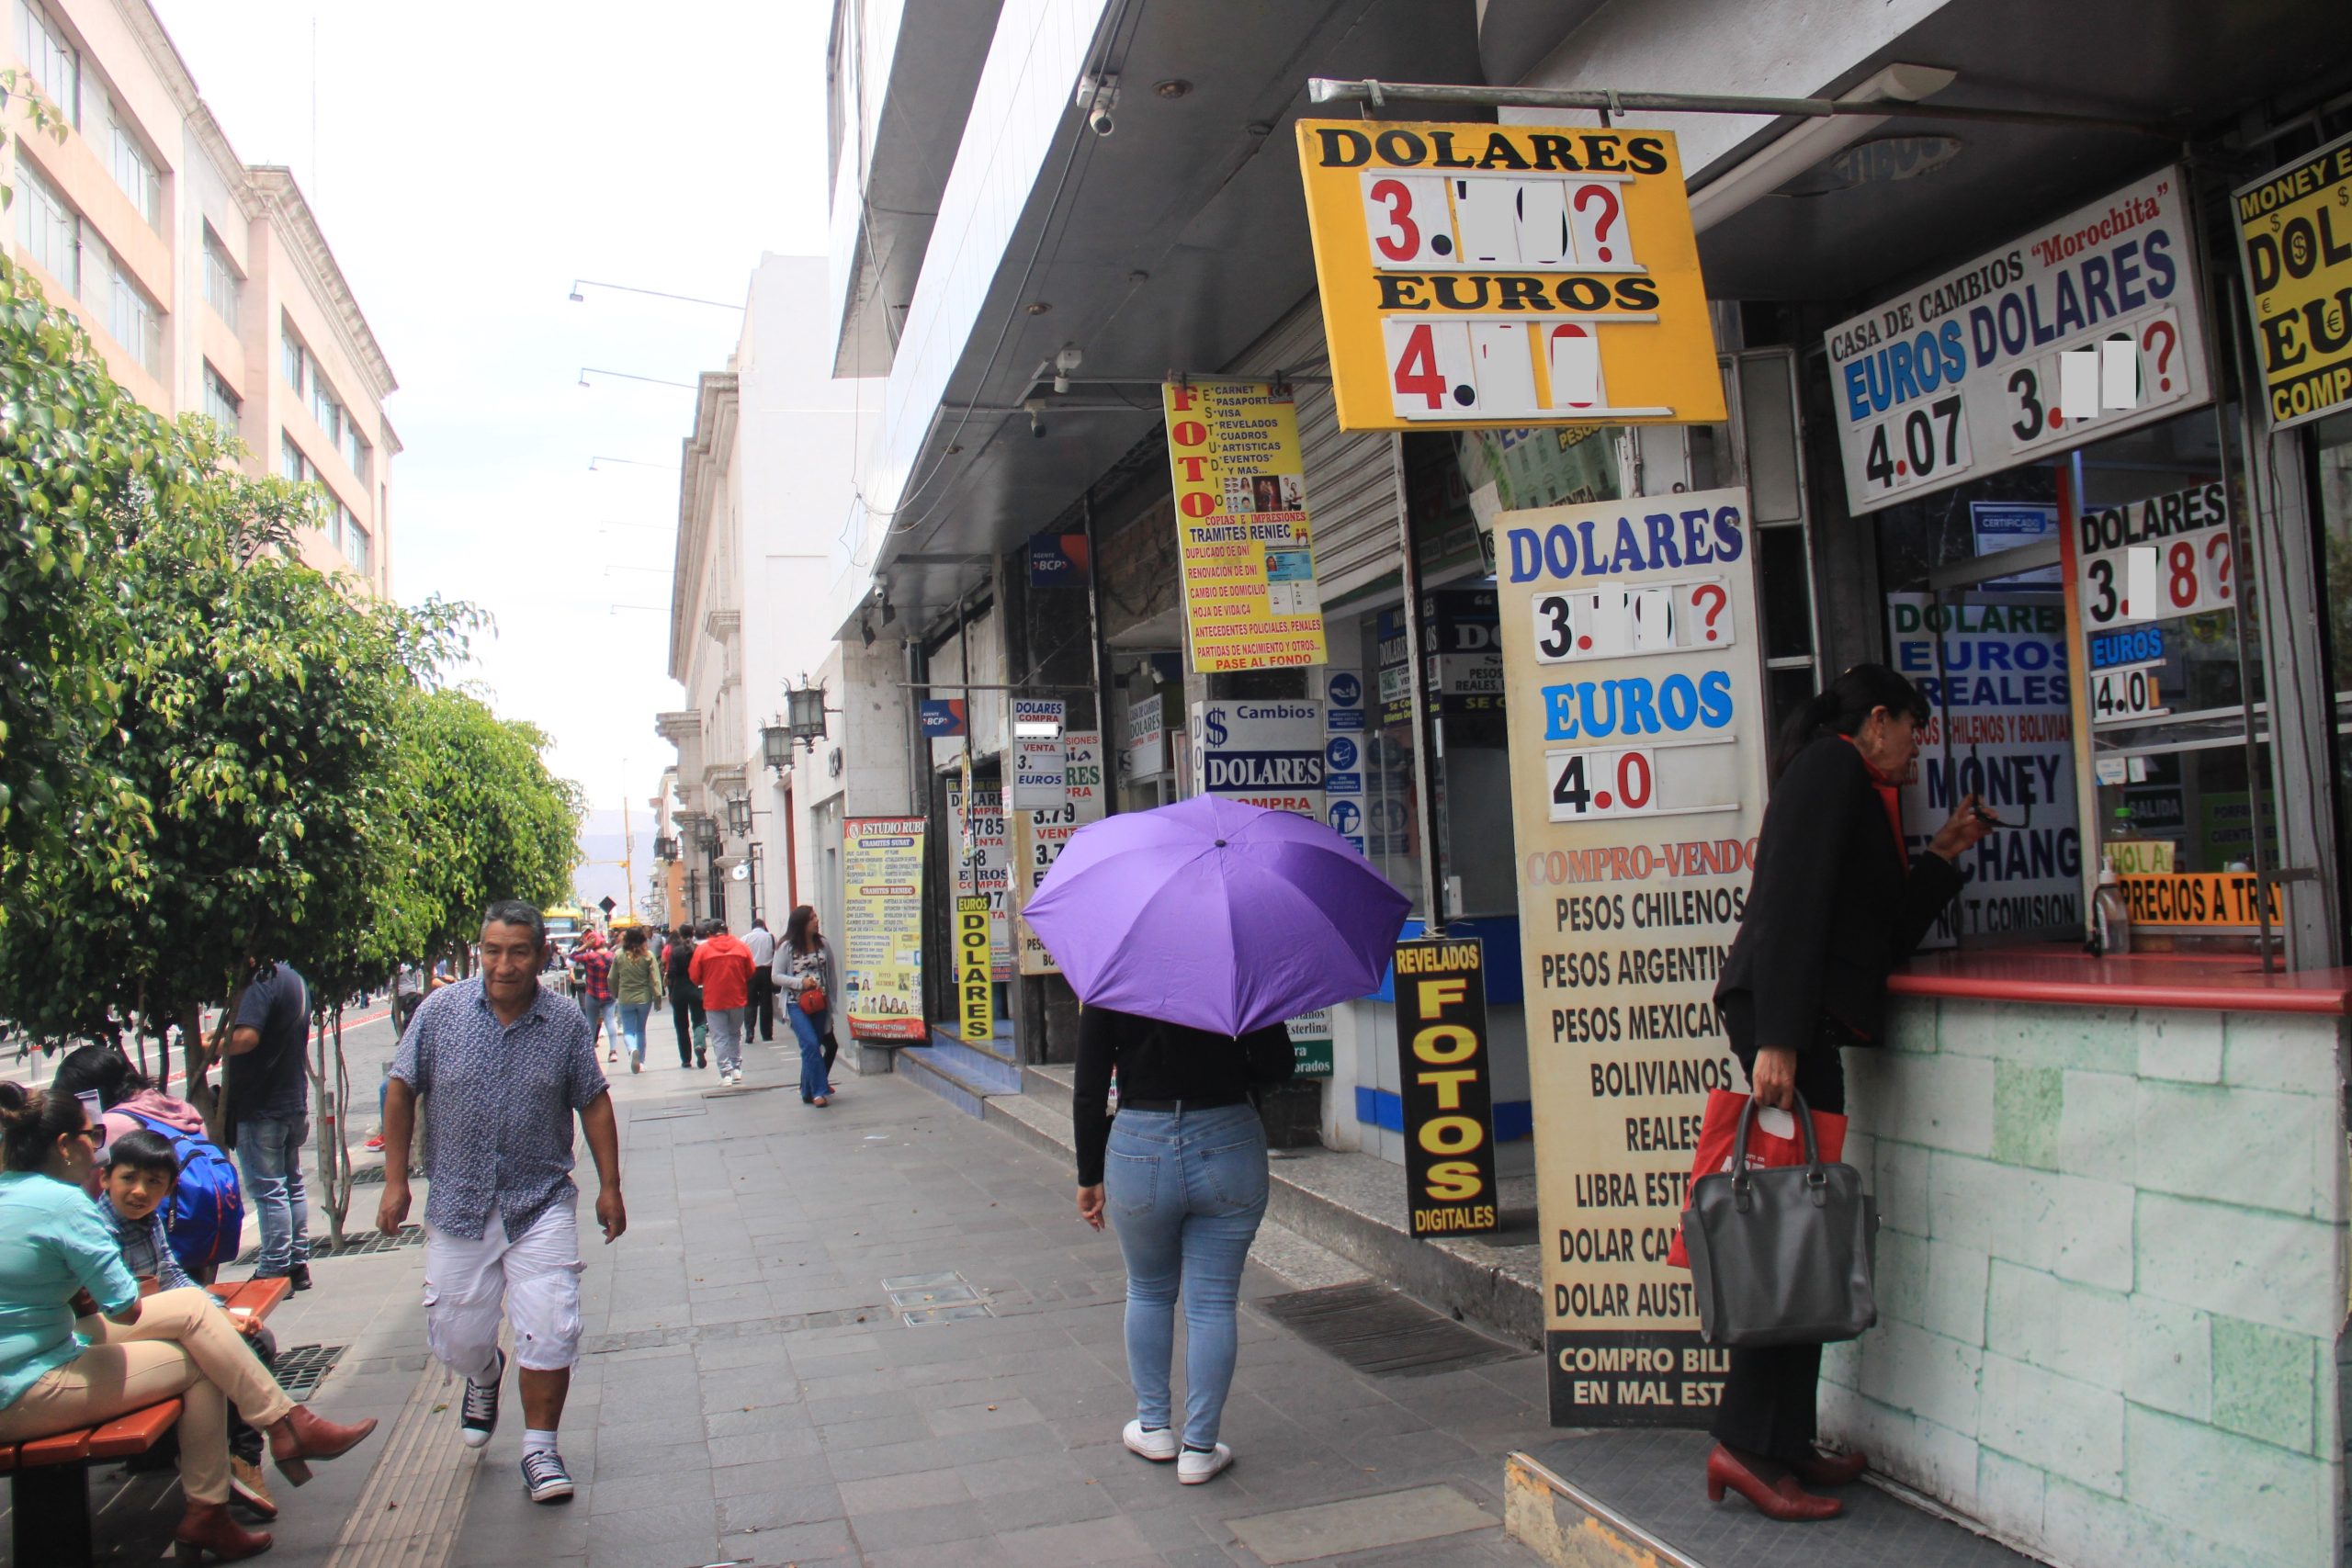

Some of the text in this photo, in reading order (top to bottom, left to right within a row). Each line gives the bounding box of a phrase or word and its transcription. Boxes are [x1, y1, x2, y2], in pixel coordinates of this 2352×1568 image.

[1317, 129, 1668, 175] DOLARES
[2240, 159, 2328, 221] MONEY
[1370, 179, 1619, 263] 3.?
[1374, 276, 1659, 310] EUROS
[1831, 328, 1881, 362] CASA
[1884, 303, 1914, 339] DE
[1918, 250, 2024, 323] CAMBIOS
[1844, 229, 2177, 422] EUROS DOLARES
[1215, 386, 1255, 394] CARNET
[1216, 396, 1275, 405] PASAPORTE
[1866, 320, 2176, 488] 4.07 3.?
[1219, 419, 1278, 429] REVELADOS
[1221, 431, 1268, 440] CUADROS
[1171, 385, 1216, 518] FOTO
[1222, 442, 1281, 452] ARTISTICAS
[1227, 467, 1234, 475] Y
[1190, 525, 1291, 542] TRAMITES RENIEC
[1205, 512, 1306, 525] COPIAS E IMPRESIONES
[2081, 483, 2225, 555] DOLARES
[1186, 546, 1250, 558] DUPLICADO DE DNI
[1508, 506, 1743, 582] DOLARES
[1188, 565, 1257, 579] RENOVACION DE DNI
[2088, 532, 2231, 623] 3.8?
[1190, 583, 1265, 599] CAMBIO DE DOMICILIO
[1193, 606, 1212, 617] HOJA
[1213, 605, 1222, 616] DE
[1539, 584, 1726, 657] 3.?
[1894, 603, 2064, 634] DOLARE
[1195, 624, 1248, 637] ANTECEDENTES
[1291, 619, 1320, 631] PENALES
[1197, 646, 1230, 658] PARTIDAS
[1231, 645, 1240, 655] DE
[1242, 642, 1283, 654] NACIMIENTO
[1285, 641, 1290, 651] Y
[1216, 654, 1312, 670] PASE AL FONDO
[2092, 627, 2163, 667] EUROS
[1015, 702, 1062, 715] DOLARES
[1541, 671, 1733, 740] EUROS
[2098, 671, 2145, 716] 4.0
[1018, 714, 1059, 722] COMPRA
[1130, 714, 1160, 739] DOLARES
[1237, 705, 1315, 719] Cambios
[2008, 716, 2016, 743] Y
[1018, 775, 1062, 784] EUROS
[1208, 757, 1321, 786] DOLARES
[1553, 752, 1651, 813] 4.0
[1927, 754, 2060, 809] MONEY
[862, 822, 900, 834] ESTUDIO
[958, 897, 988, 910] EUROS
[1555, 886, 1745, 932] PESOS CHILENOS
[1986, 894, 2075, 931] COMISION
[2120, 877, 2205, 921] PRECIOS
[2213, 878, 2228, 920] A
[1396, 944, 1478, 974] REVELADOS
[1542, 951, 1610, 988] PESOS
[963, 914, 988, 1037] DOLARES
[1552, 1007, 1621, 1043] PESOS
[1412, 978, 1483, 1201] FOTOS
[1590, 1057, 1732, 1097] BOLIVIANOS
[1625, 1114, 1702, 1152] REALES
[1576, 1173, 1638, 1208] LIBRA
[1415, 1205, 1494, 1232] DIGITALES
[1559, 1228, 1634, 1263] DOLAR
[1555, 1282, 1700, 1317] DOLAR AUST
[1559, 1348, 1674, 1373] COMPRO
[1574, 1381, 1725, 1405] EN MAL EST
